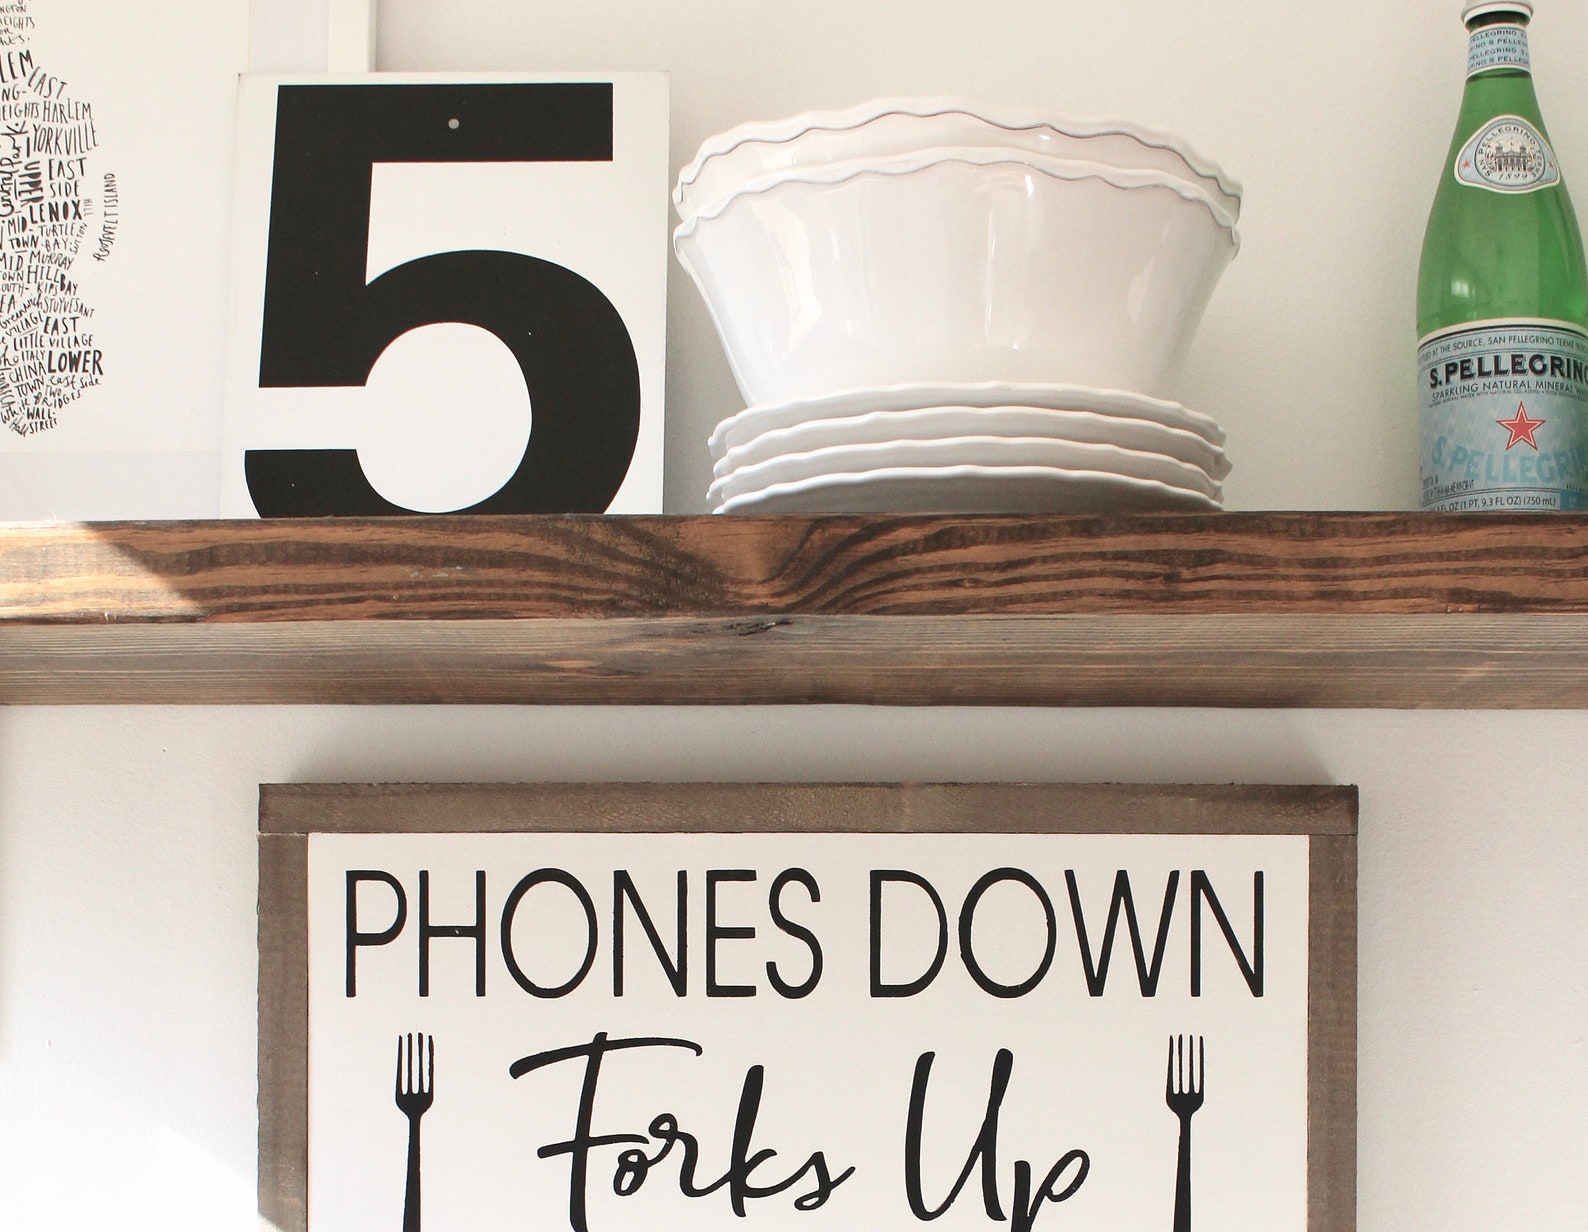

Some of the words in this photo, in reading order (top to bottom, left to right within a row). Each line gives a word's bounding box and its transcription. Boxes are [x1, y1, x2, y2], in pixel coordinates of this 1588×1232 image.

[28, 66, 68, 100] EAST
[0, 102, 40, 121] EIGHTS
[42, 98, 94, 124] HARLEM
[33, 121, 100, 156] YORKVILLE
[1478, 126, 1537, 155] PELLEGRINO
[48, 157, 88, 181] EAST
[18, 160, 45, 208] UPPER
[50, 180, 80, 198] SIDE
[103, 173, 119, 209] ISLAND
[29, 199, 83, 225] LENOX
[37, 222, 77, 238] TURTLE
[8, 235, 39, 250] TOWN
[29, 250, 75, 271] MURRAY
[0, 270, 24, 282] OWN
[27, 264, 59, 285] HILL
[60, 273, 79, 296] BAY
[36, 281, 58, 297] KIPS
[245, 83, 640, 514] 5
[43, 296, 96, 319] STUYVESANT
[43, 315, 80, 337] EAST
[13, 330, 44, 352] LITTLE
[1440, 343, 1452, 354] THE
[1452, 338, 1486, 352] SOURCE,
[1487, 335, 1507, 346] SAN
[1507, 334, 1555, 346] PELLEGRINO
[21, 350, 46, 363] ITALY
[47, 349, 104, 376] LOWER
[9, 360, 47, 384] CHINA
[15, 375, 45, 398] TOWN
[1431, 382, 1479, 402] SPARKLING
[1482, 379, 1532, 392] NATURAL
[1534, 379, 1574, 395] MINERAL
[29, 417, 58, 435] STREET
[1482, 497, 1494, 507] 9.3
[1495, 497, 1505, 507] FL
[1506, 495, 1521, 507] OZ)
[1523, 495, 1541, 507] (750
[1542, 495, 1556, 507] mL)
[346, 868, 822, 999] PHONES
[870, 868, 1264, 998] DOWN
